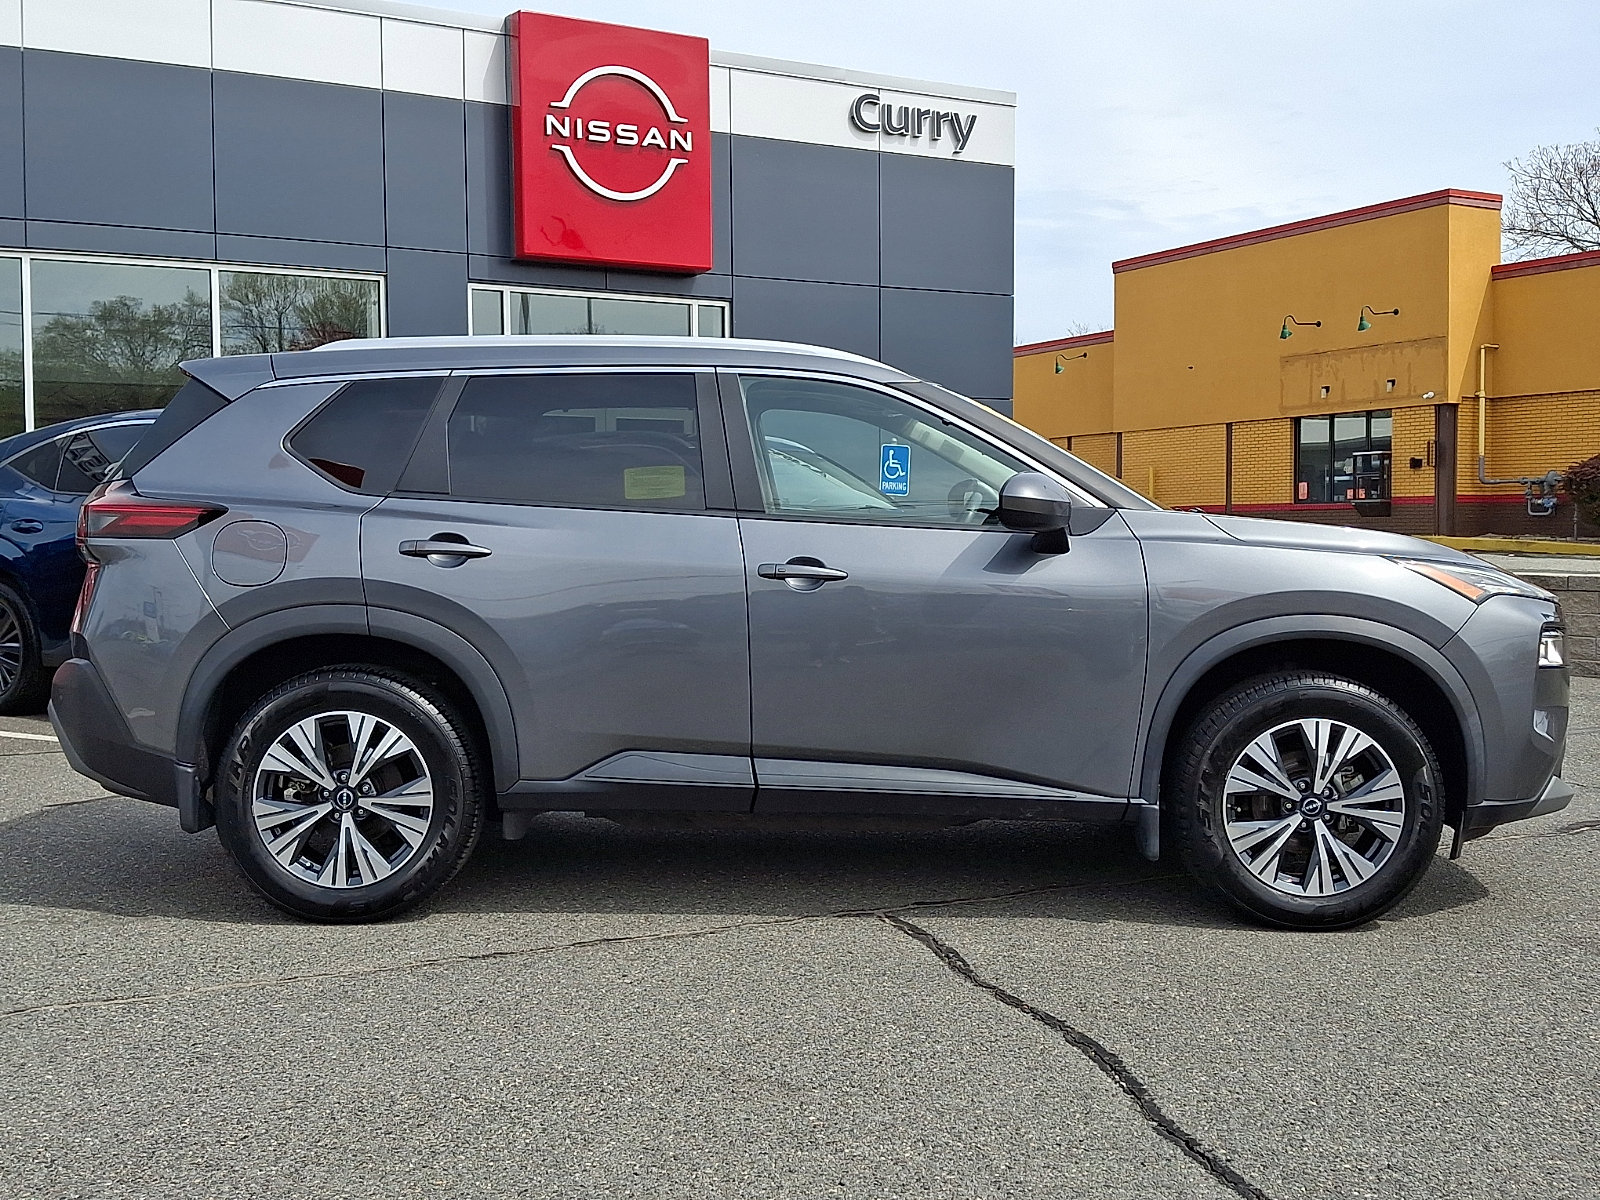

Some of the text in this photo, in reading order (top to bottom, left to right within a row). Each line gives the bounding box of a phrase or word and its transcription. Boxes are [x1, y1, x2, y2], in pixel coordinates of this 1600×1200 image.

[545, 114, 693, 152] NISSAN
[850, 93, 978, 154] Curry
[882, 481, 907, 491] PARKING
